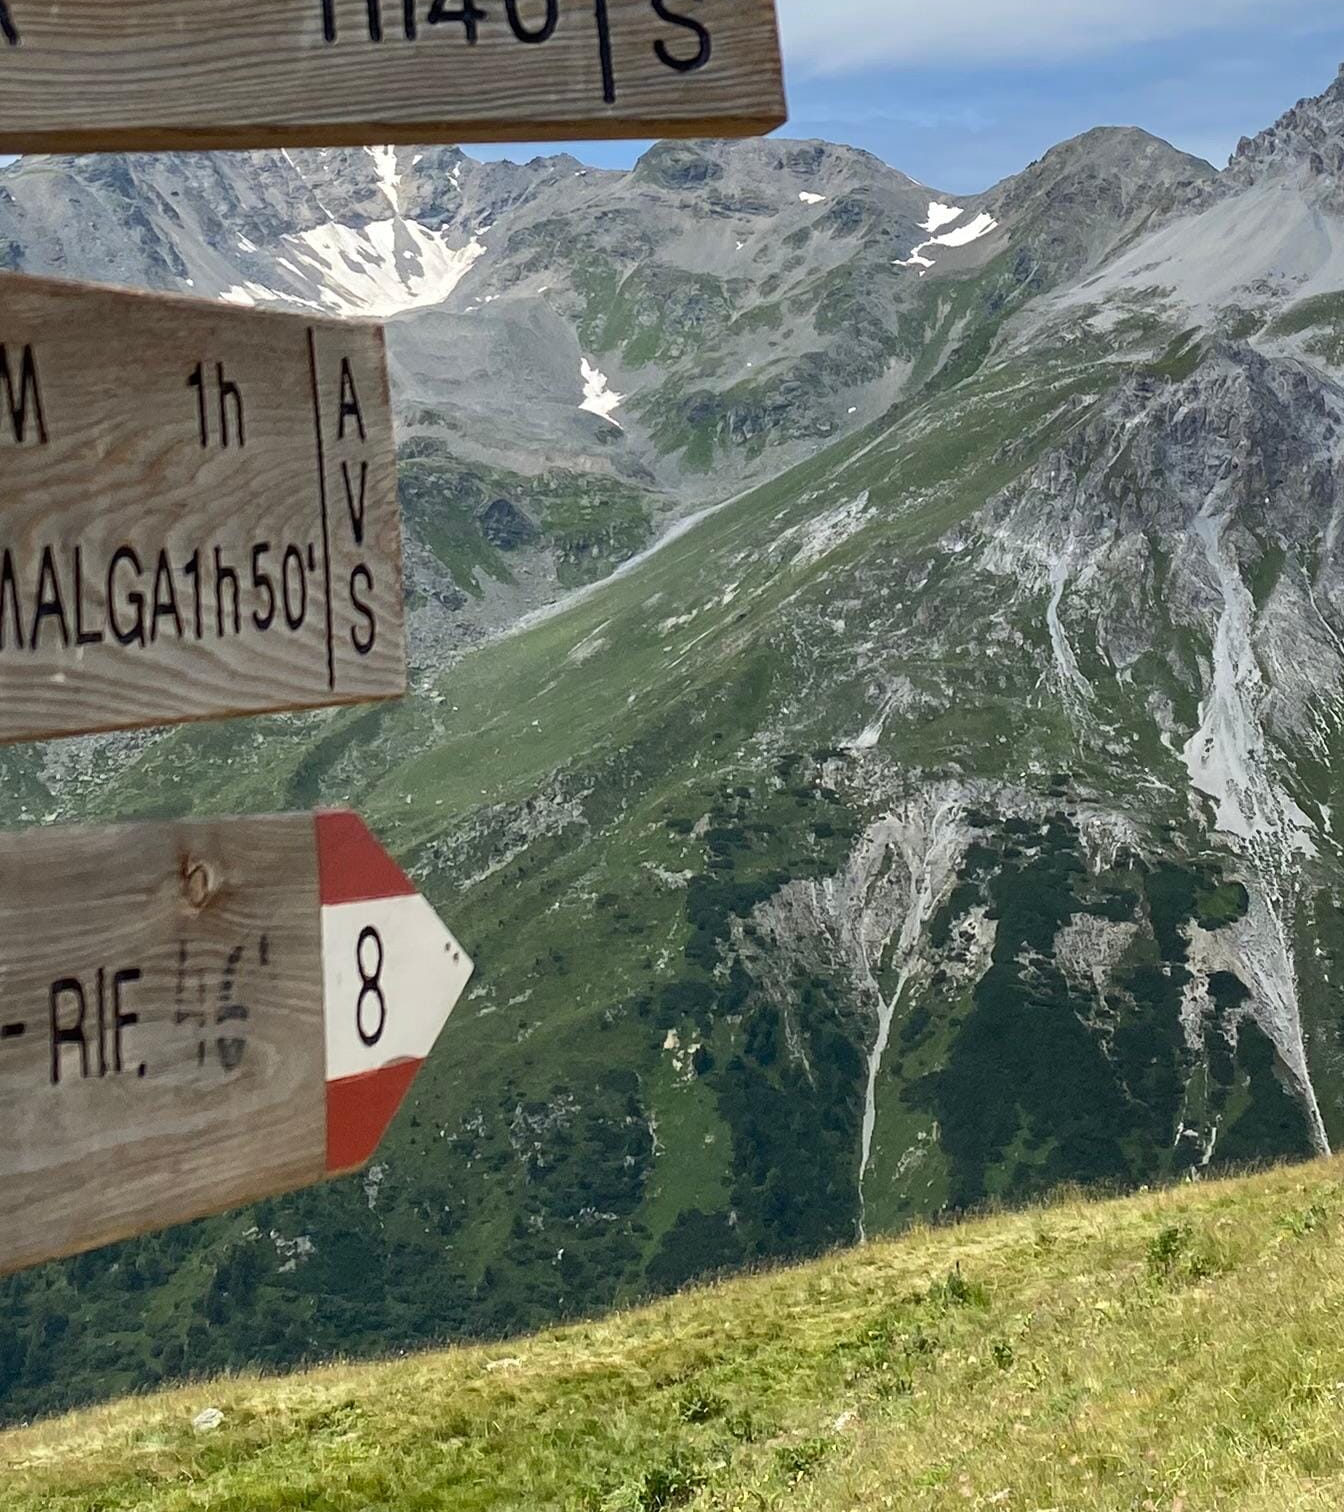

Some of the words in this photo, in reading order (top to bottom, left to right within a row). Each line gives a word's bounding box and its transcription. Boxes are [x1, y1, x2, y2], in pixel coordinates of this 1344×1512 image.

[184, 359, 246, 450] 1h
[336, 354, 377, 657] AVS
[354, 924, 387, 1048] 8
